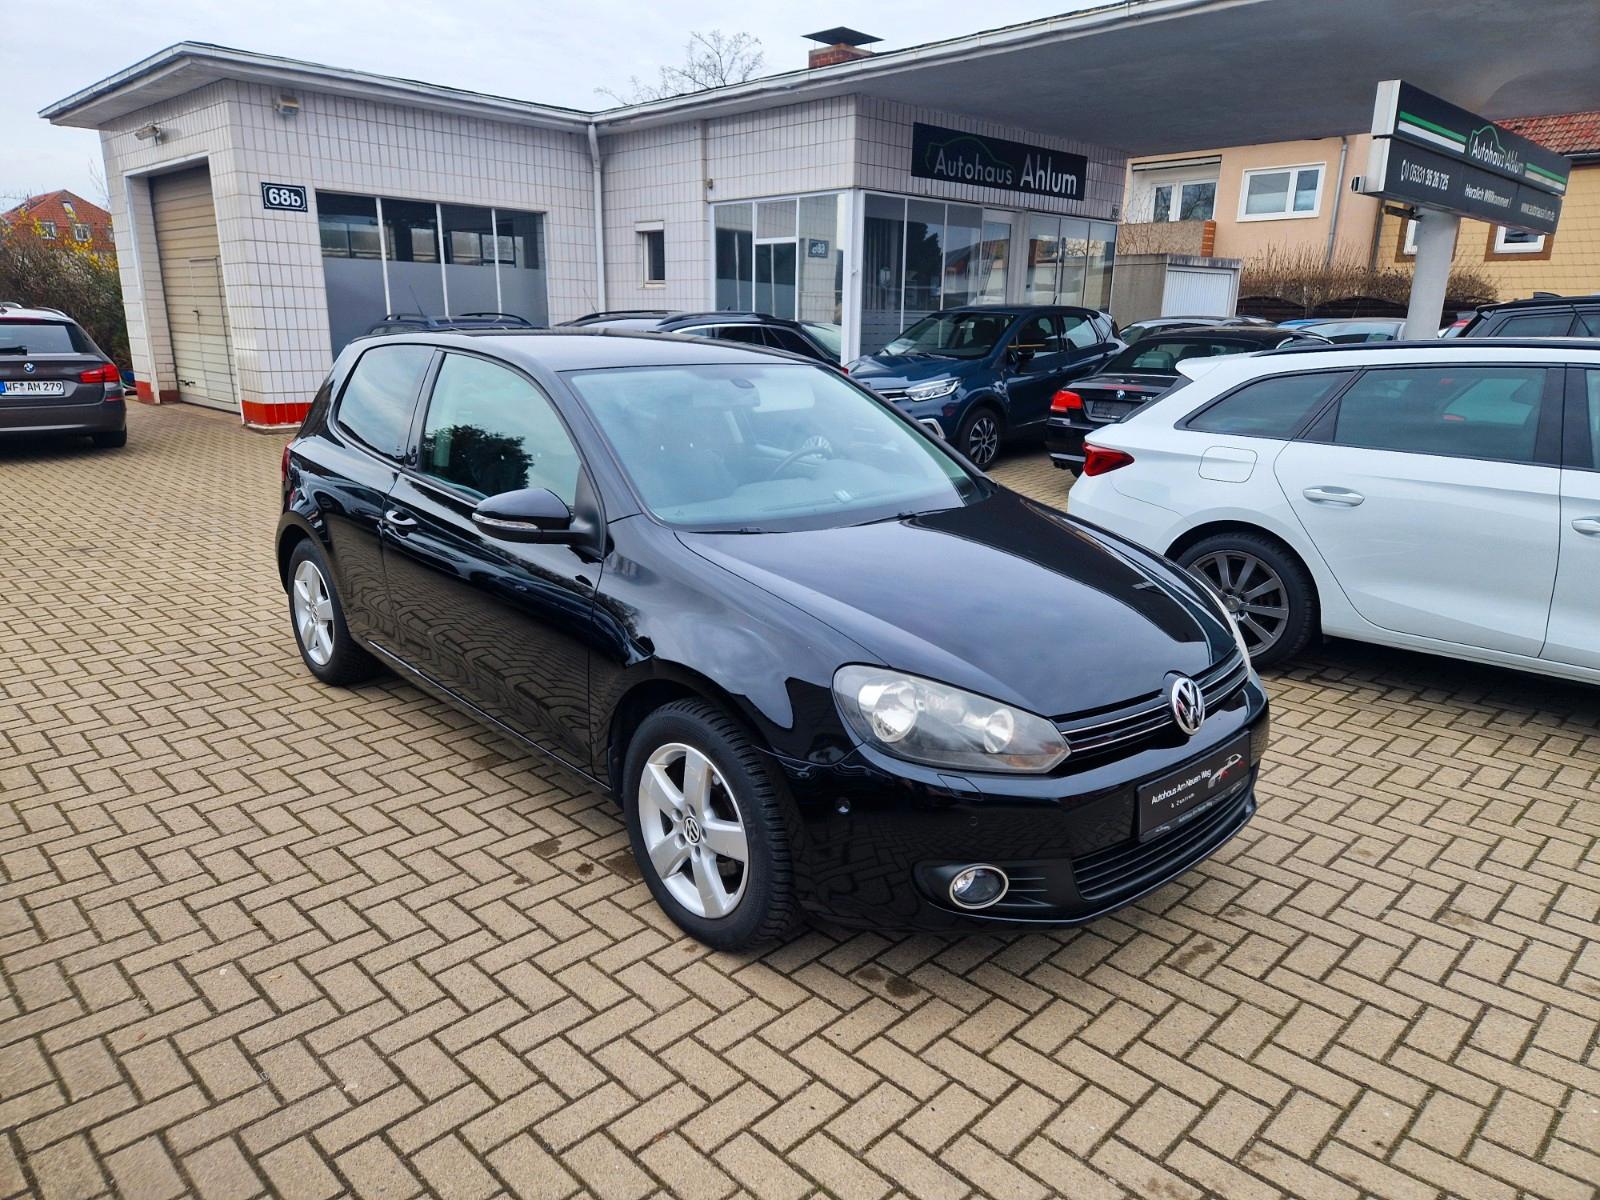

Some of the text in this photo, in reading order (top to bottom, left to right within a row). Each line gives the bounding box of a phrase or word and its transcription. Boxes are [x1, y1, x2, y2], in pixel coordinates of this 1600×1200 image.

[1472, 136, 1524, 174] Autohaus Ahlum
[934, 147, 1077, 195] Autohaus Ahlum
[1409, 163, 1426, 184] 05331
[269, 188, 301, 206] 68b
[1465, 184, 1484, 200] Herzlich
[5, 382, 62, 391] WF AM 279
[1151, 769, 1212, 805] Autohaus Am Neuen Weg
